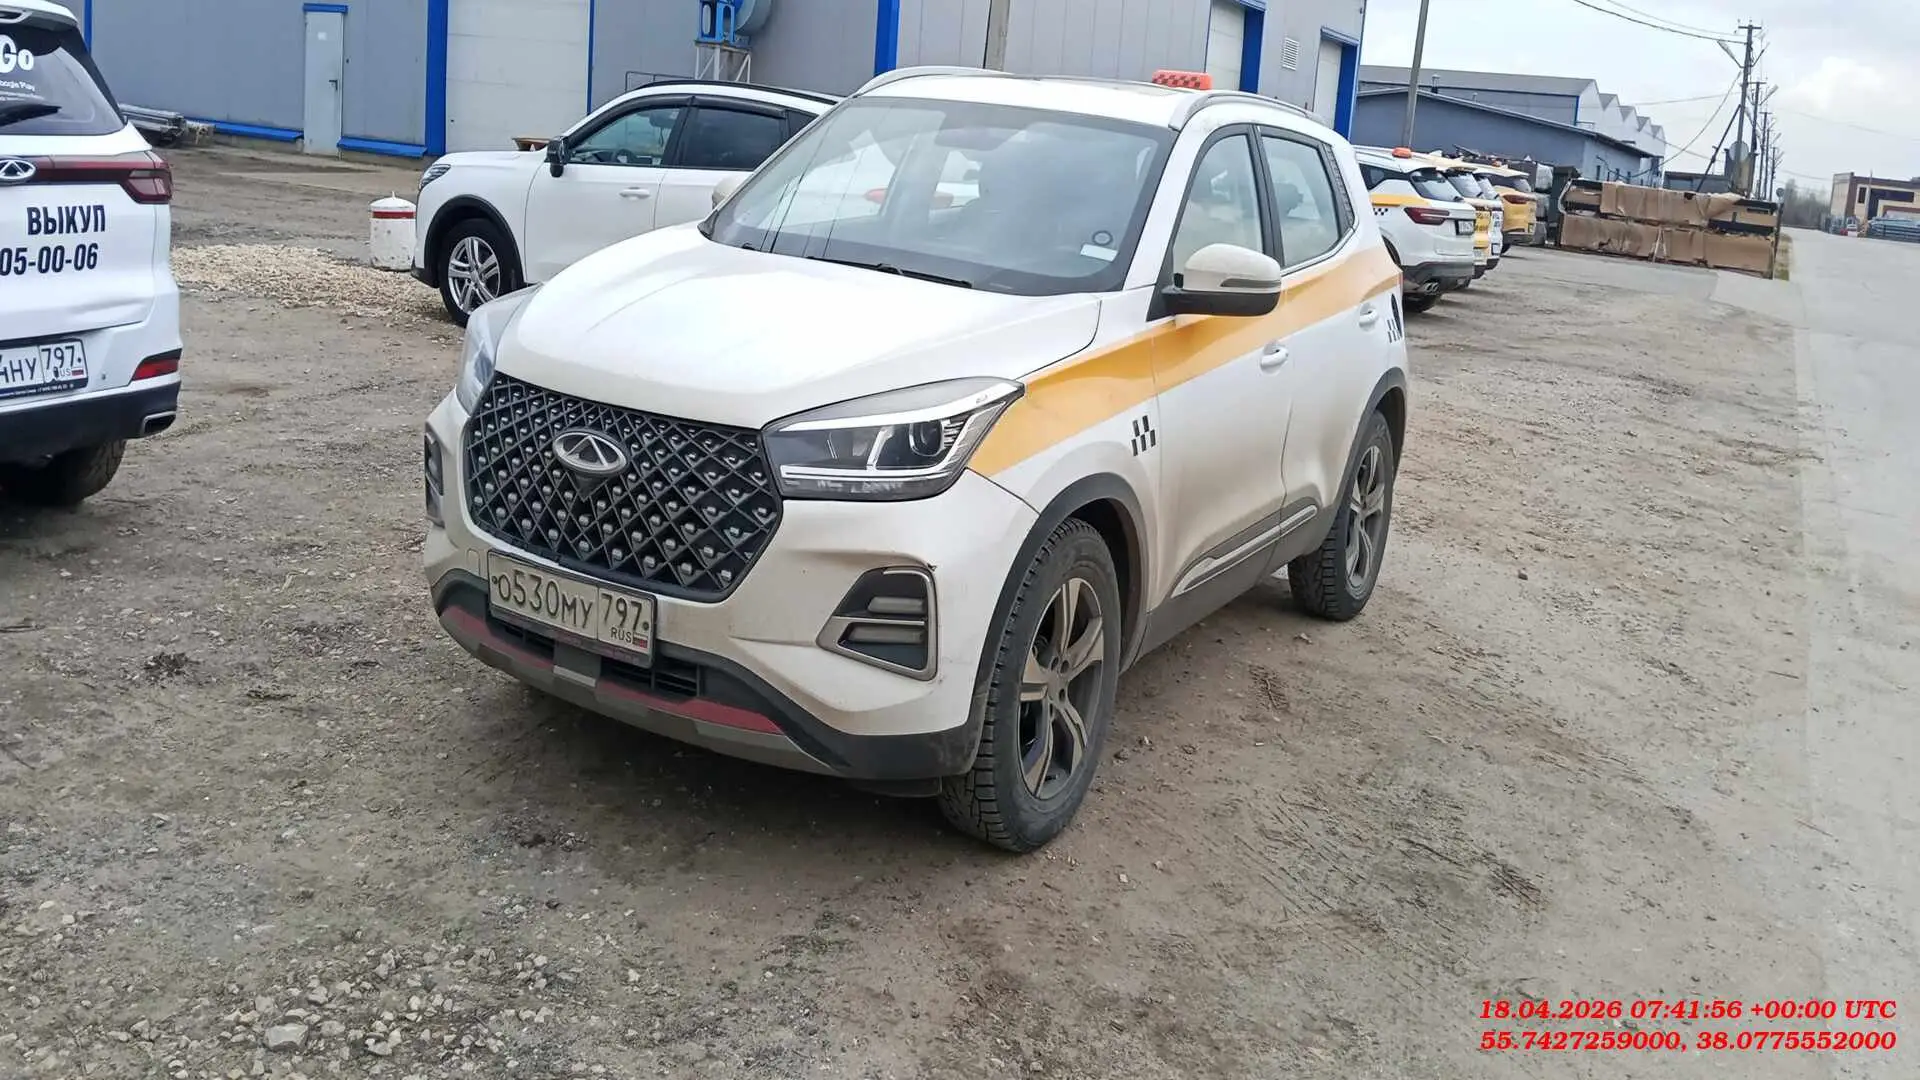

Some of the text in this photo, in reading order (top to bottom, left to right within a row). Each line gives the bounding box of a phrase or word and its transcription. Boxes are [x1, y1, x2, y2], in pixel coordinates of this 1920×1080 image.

[27, 205, 105, 235] ВЫКУП
[0, 243, 99, 276] 05-00-06
[41, 345, 75, 370] 797
[601, 593, 642, 632] 797
[610, 627, 632, 644] RUS
